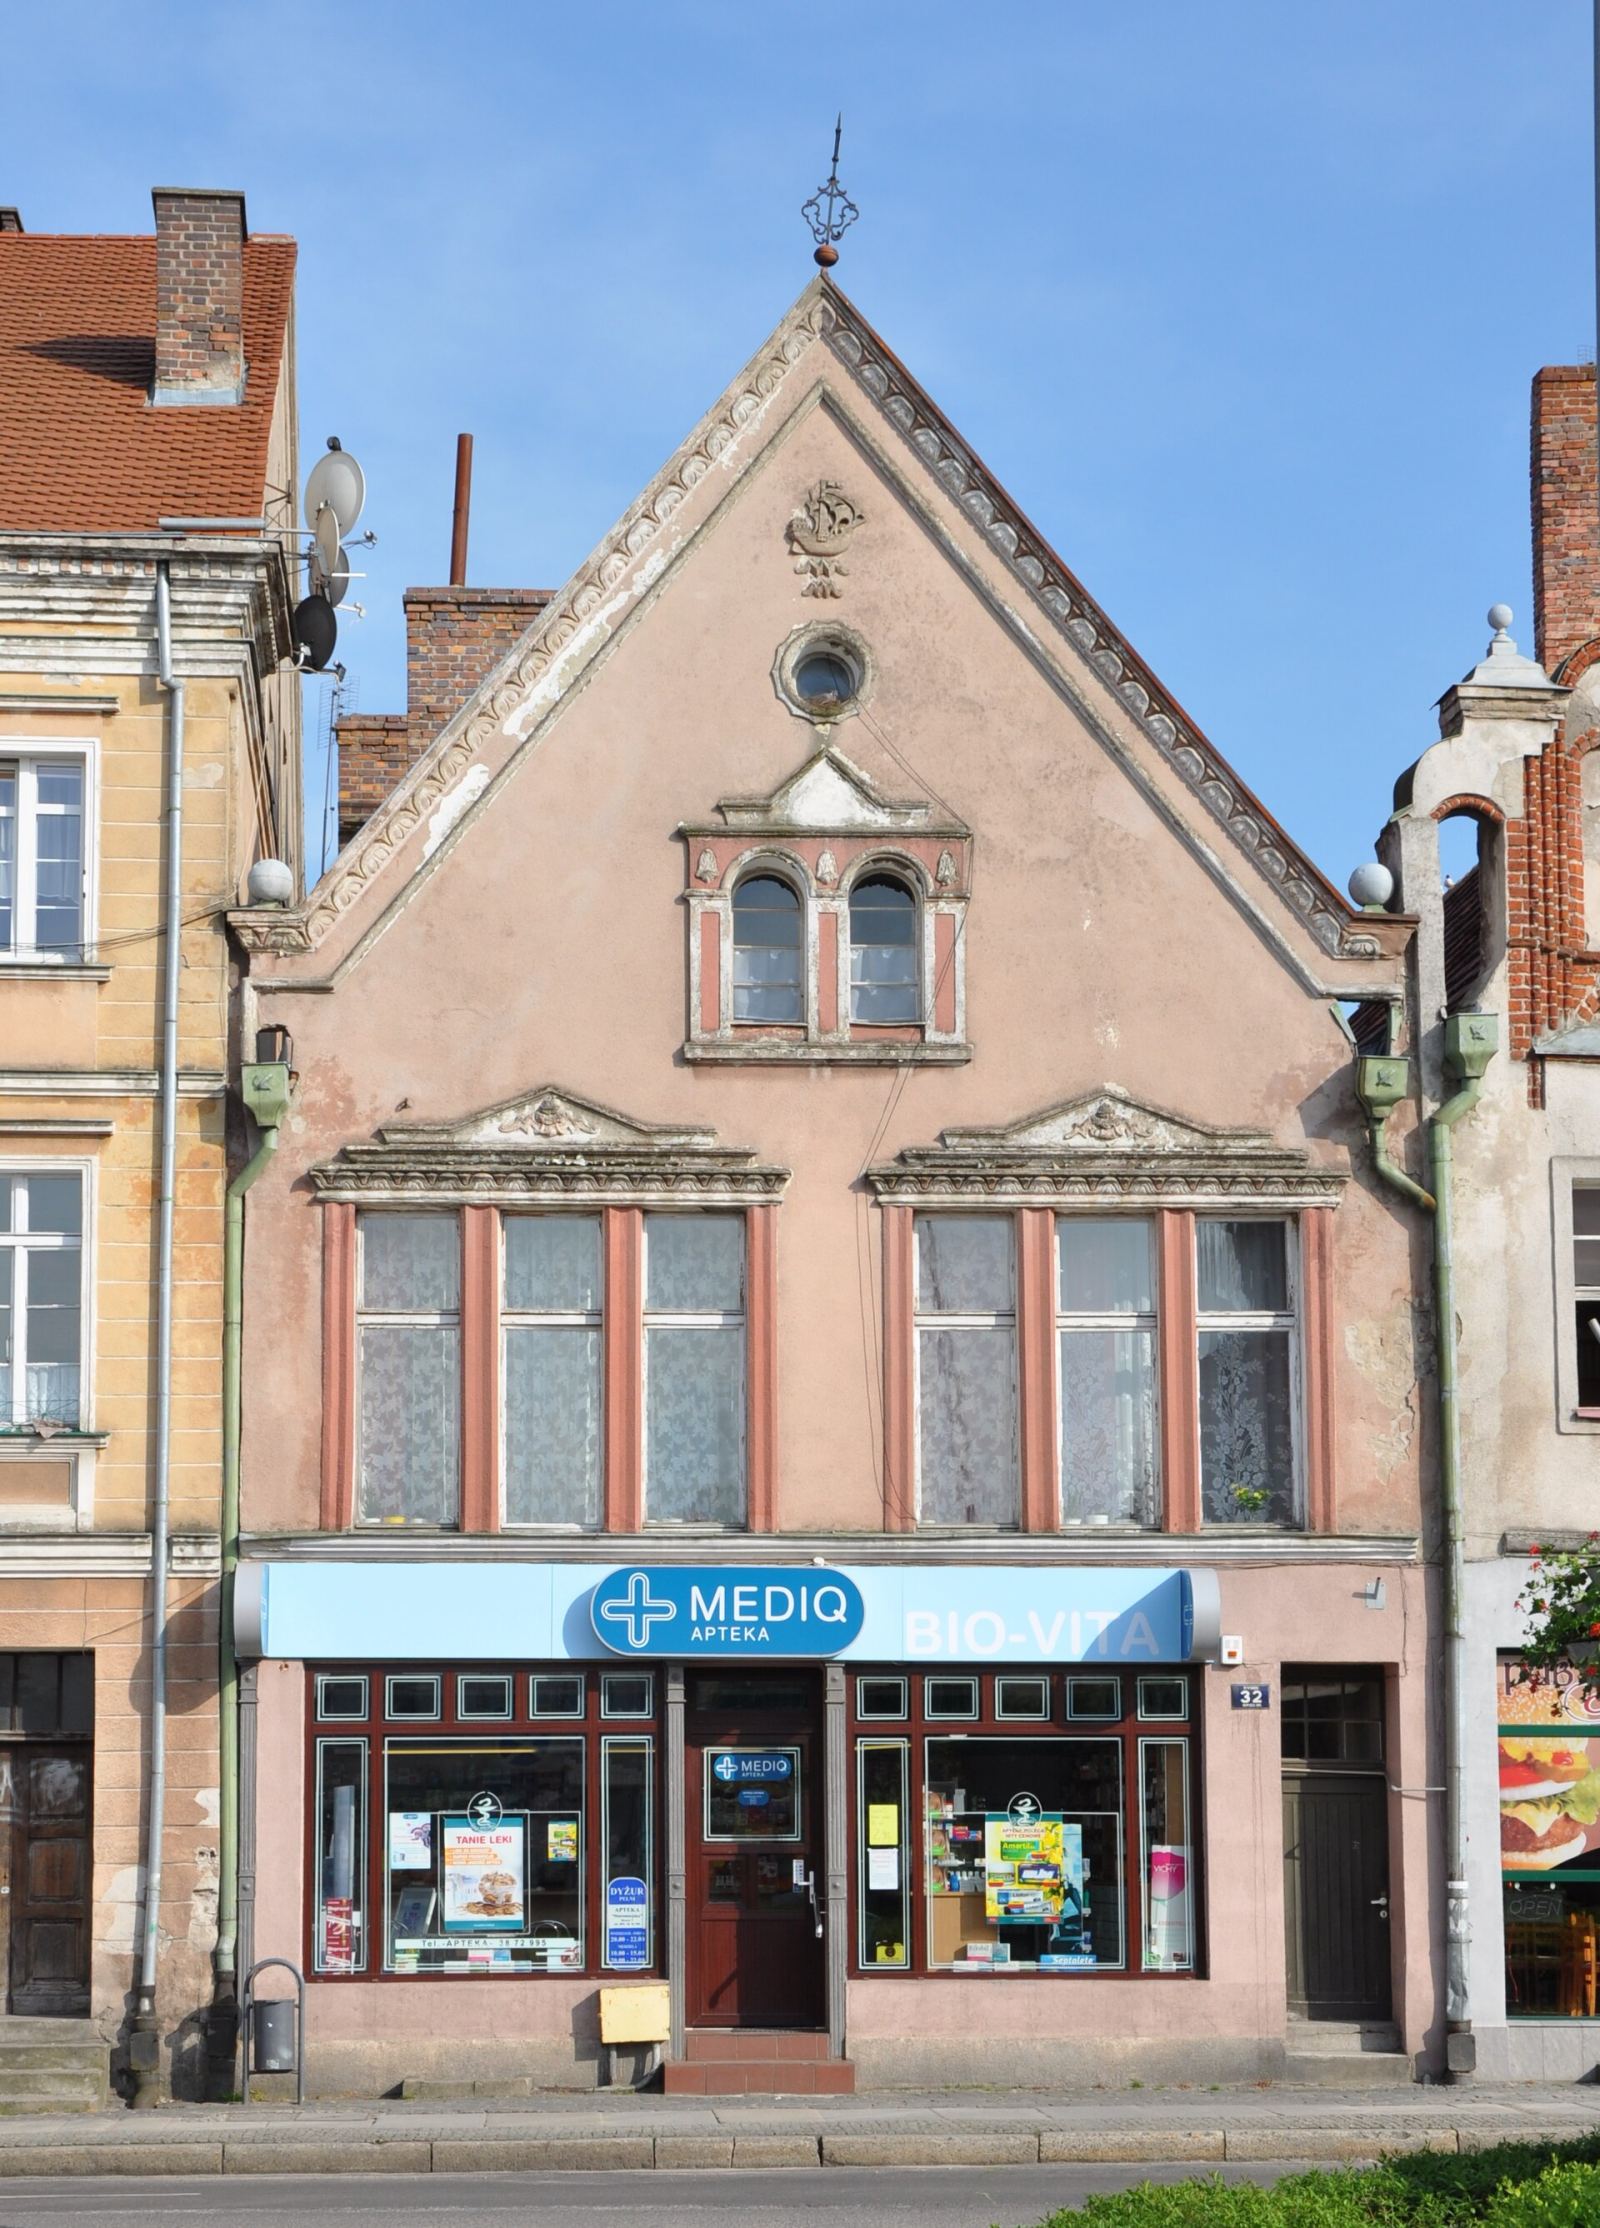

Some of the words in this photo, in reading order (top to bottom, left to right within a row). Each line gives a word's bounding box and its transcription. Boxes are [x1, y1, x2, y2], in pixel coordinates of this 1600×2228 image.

[690, 1585, 848, 1624] MEDIQ
[690, 1626, 770, 1642] APTEKA
[905, 1611, 1160, 1656] BIO-VITA
[1240, 1690, 1263, 1704] 32
[741, 1760, 788, 1773] MEDIQ
[456, 1835, 486, 1845] TANIE
[489, 1835, 513, 1844] LEKI
[1153, 1865, 1177, 1873] VICHY
[610, 1885, 644, 1896] DYŻUR
[1509, 1900, 1561, 1916] OPEN
